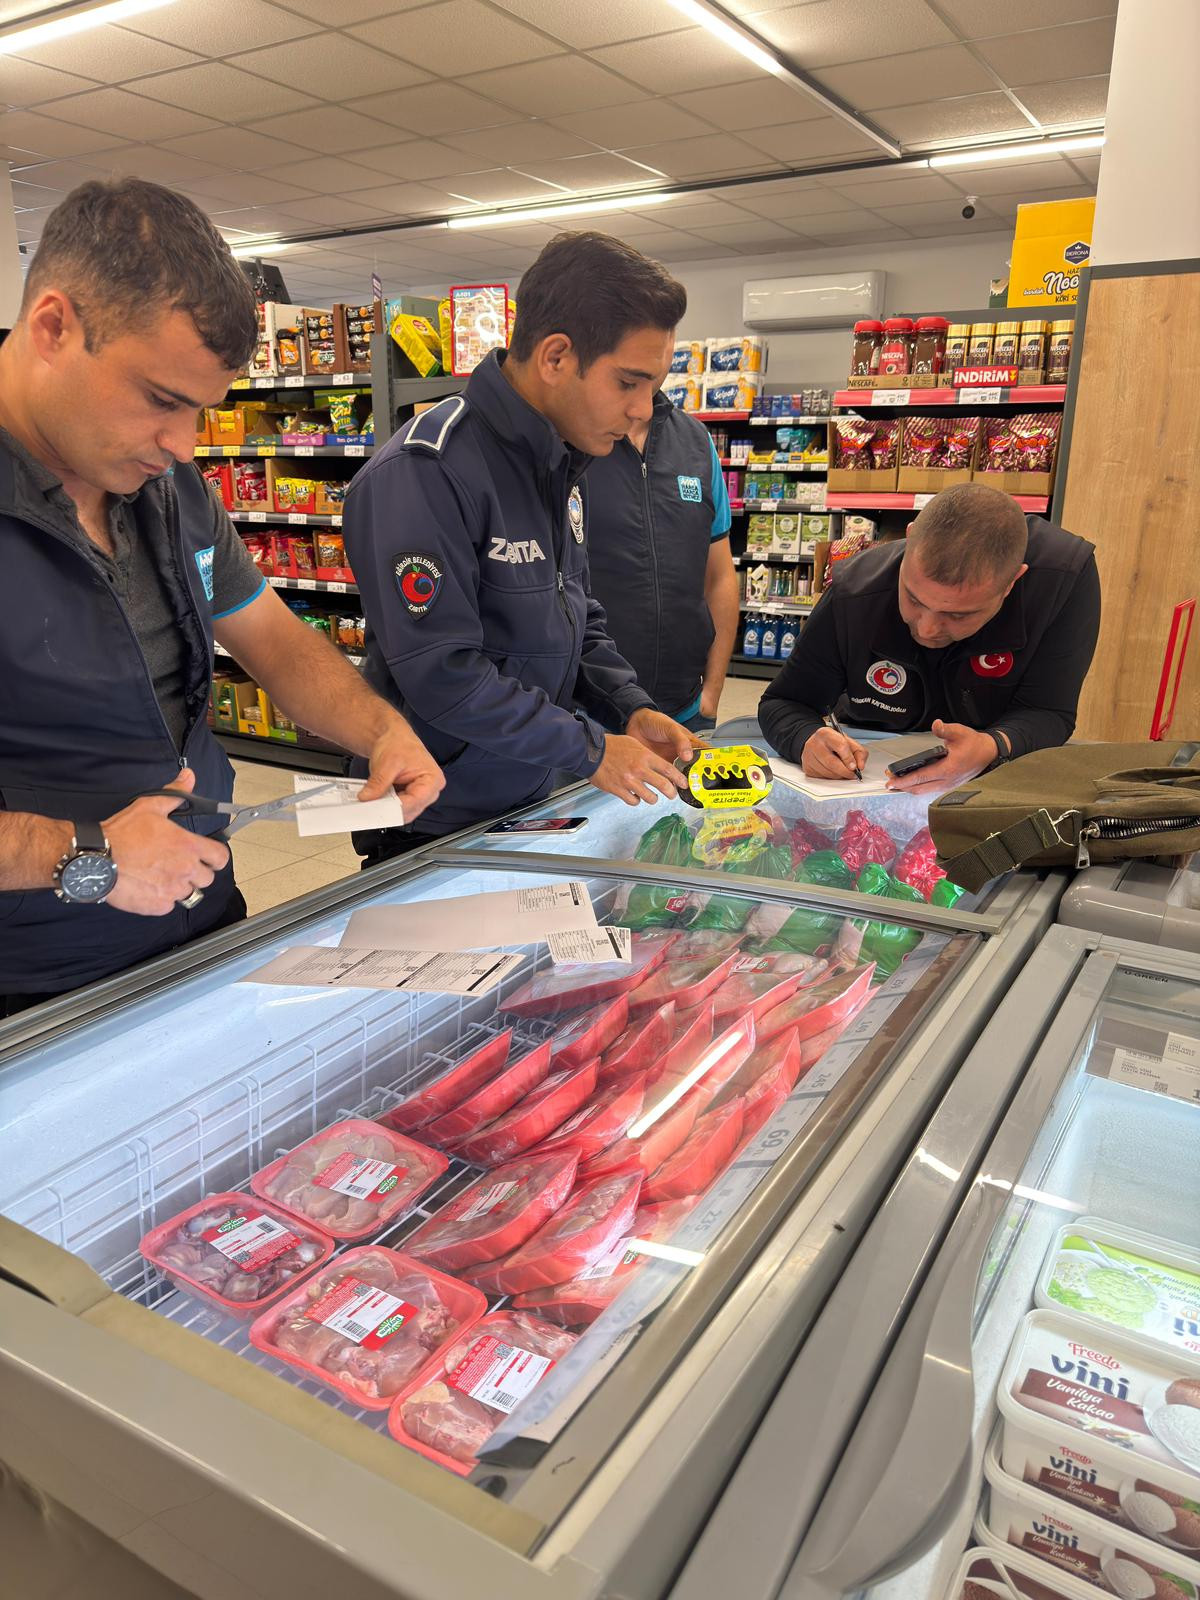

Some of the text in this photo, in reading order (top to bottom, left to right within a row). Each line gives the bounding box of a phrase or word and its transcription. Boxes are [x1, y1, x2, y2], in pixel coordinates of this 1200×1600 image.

[1068, 1341, 1120, 1370] Freedo
[1046, 1378, 1103, 1404] Vanilya
[1051, 1354, 1129, 1400] vini
[1066, 1397, 1115, 1420] Kakao
[1049, 1471, 1082, 1486] Vanilya
[1050, 1455, 1097, 1484] vini
[1032, 1520, 1078, 1549] vini
